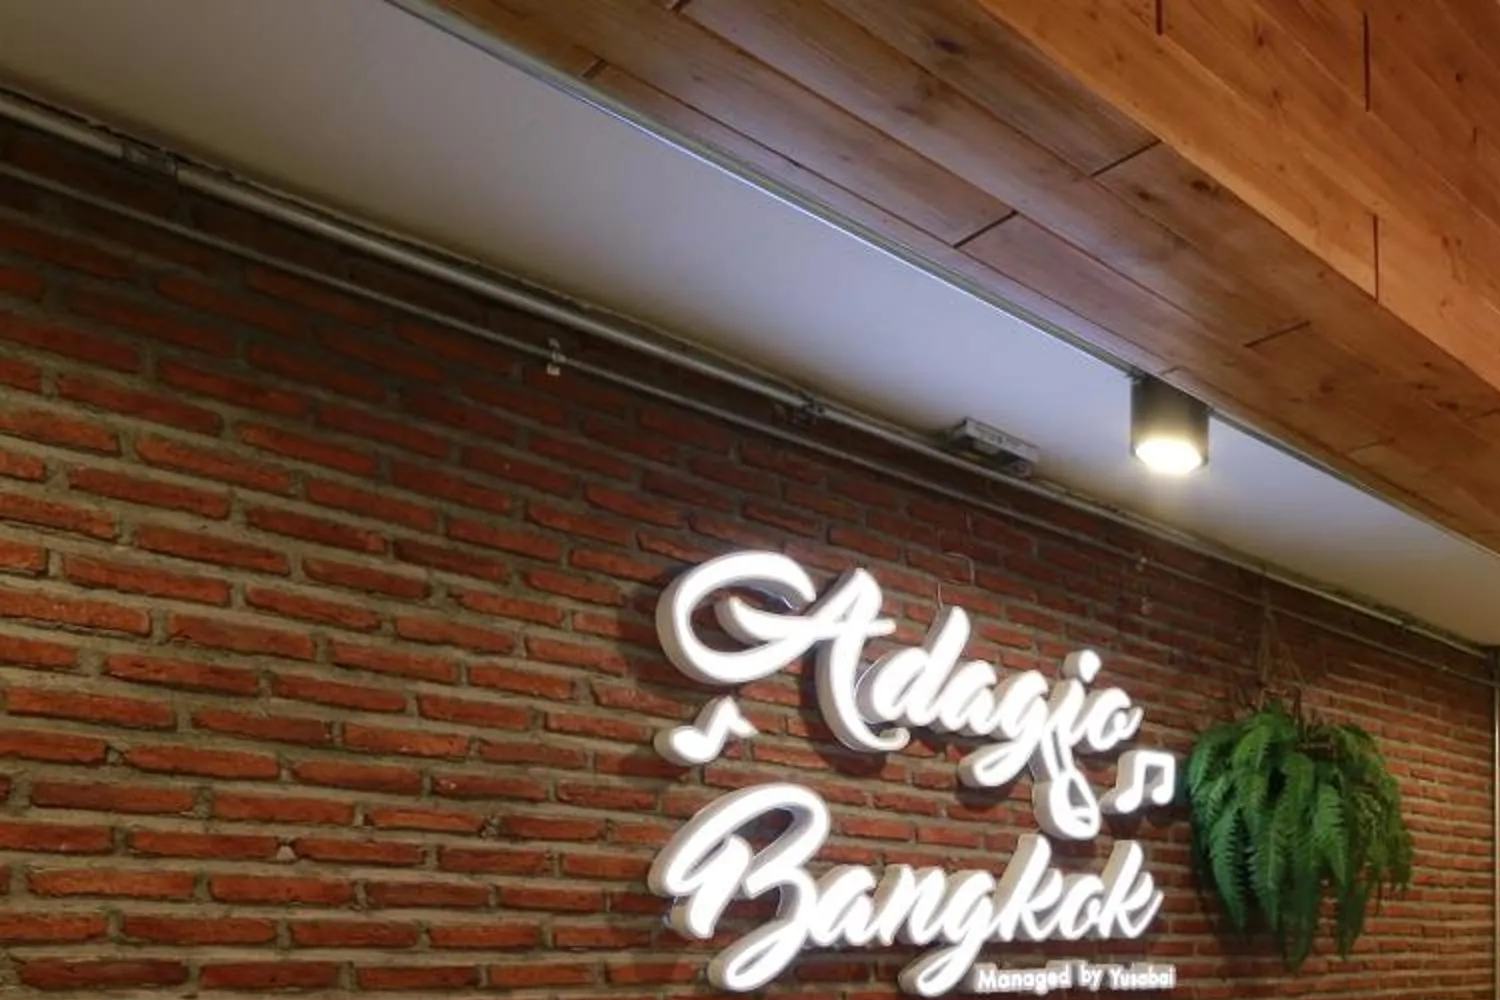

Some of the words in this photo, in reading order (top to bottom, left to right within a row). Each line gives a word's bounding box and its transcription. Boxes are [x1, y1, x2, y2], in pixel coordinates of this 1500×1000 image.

[656, 550, 1143, 840] Adagio
[648, 783, 1164, 996] Bangkok
[976, 961, 1073, 994] Managed
[1078, 962, 1104, 990] by
[1109, 964, 1177, 989] Yusabai
